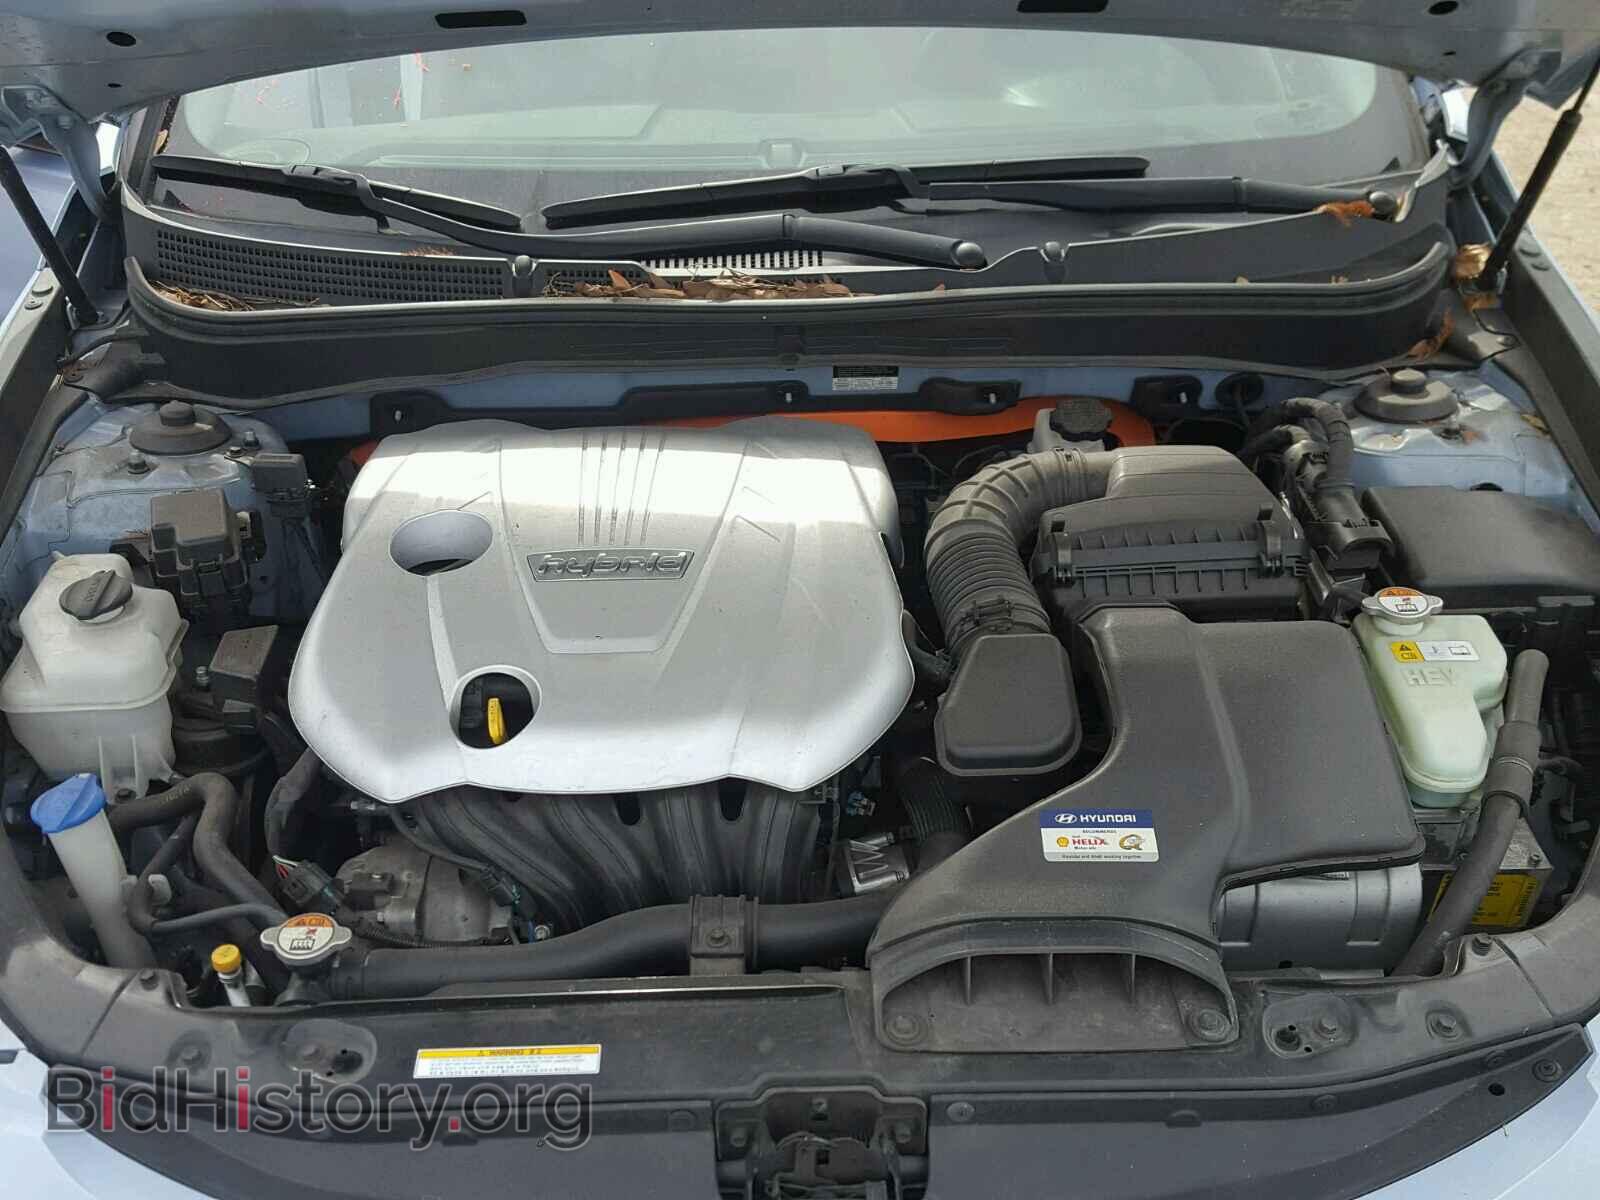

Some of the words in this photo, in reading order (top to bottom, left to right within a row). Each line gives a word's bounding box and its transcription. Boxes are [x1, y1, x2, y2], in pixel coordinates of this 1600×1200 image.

[1401, 667, 1457, 687] HEV
[1080, 814, 1137, 823] HYUNDAI
[1072, 838, 1105, 846] HELIX
